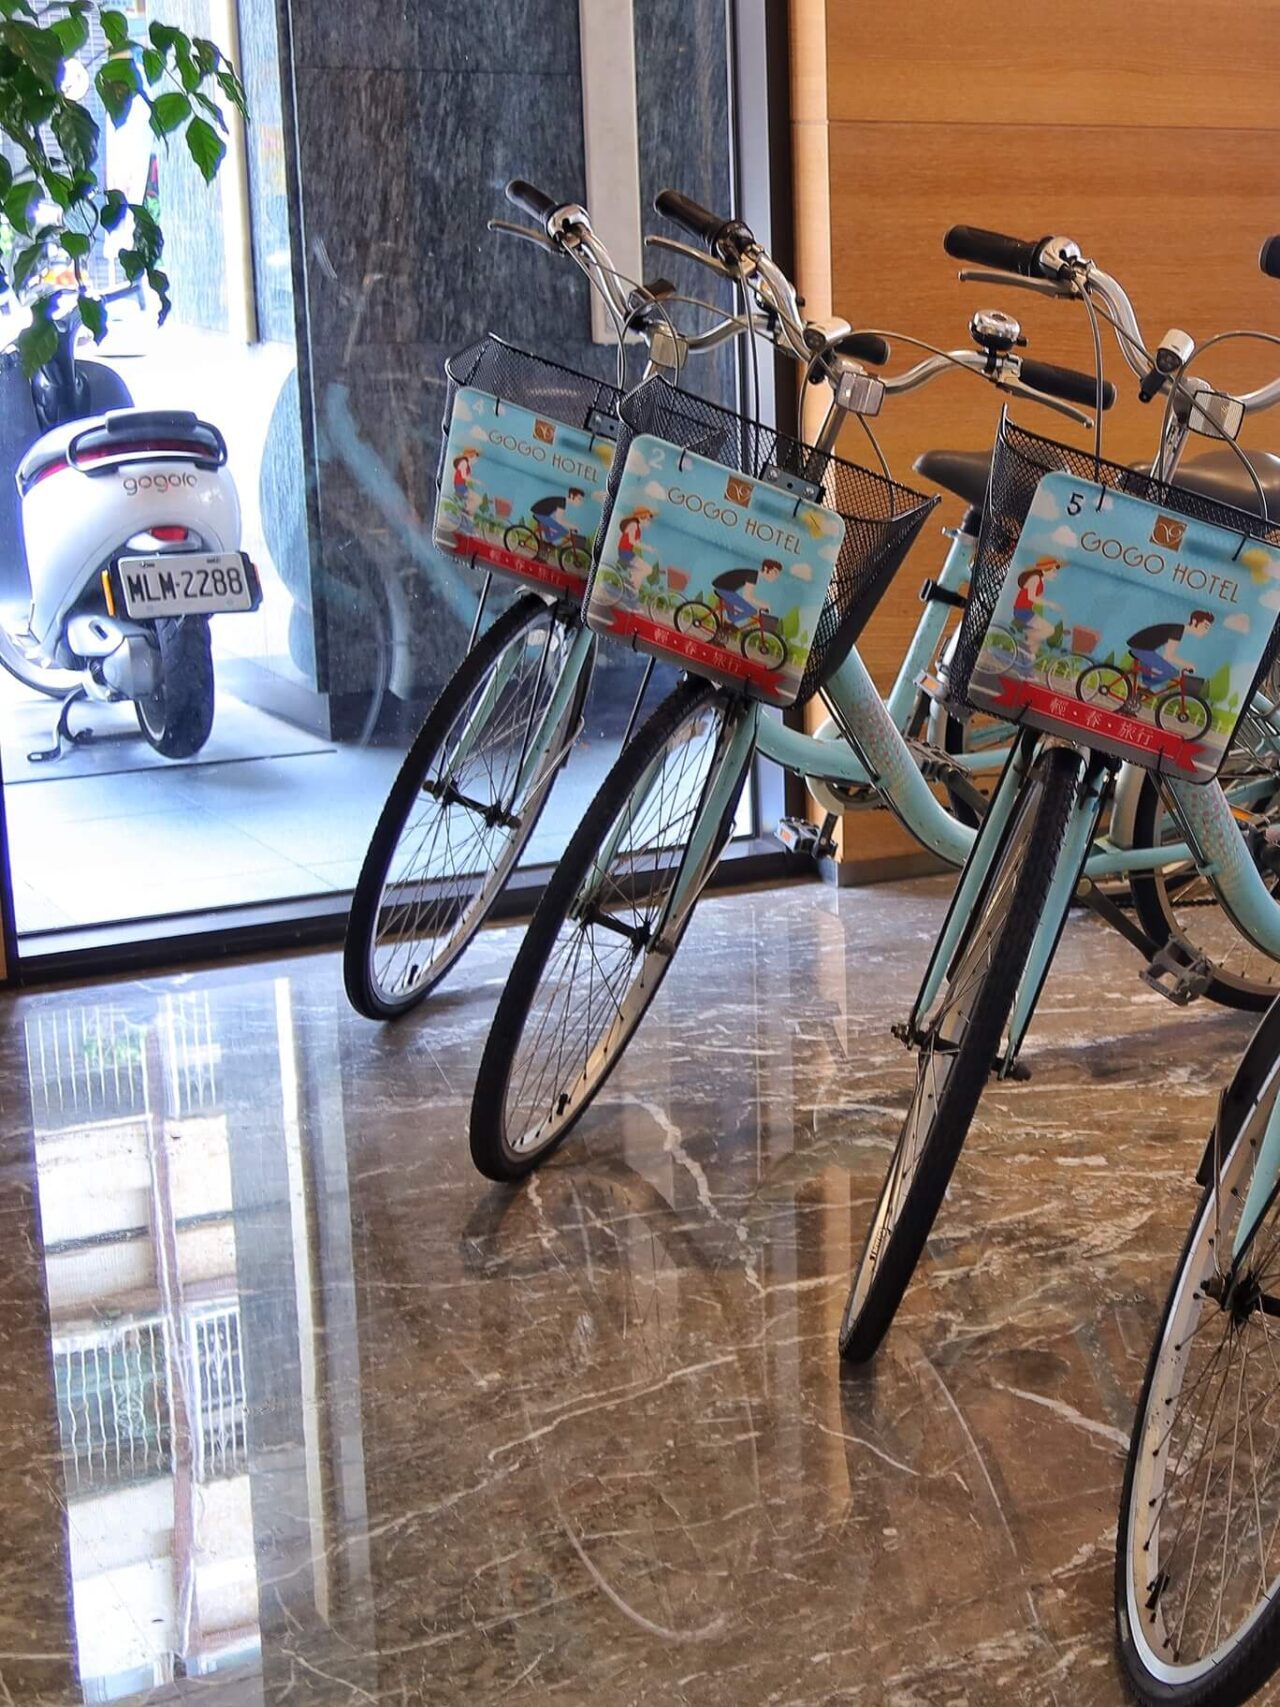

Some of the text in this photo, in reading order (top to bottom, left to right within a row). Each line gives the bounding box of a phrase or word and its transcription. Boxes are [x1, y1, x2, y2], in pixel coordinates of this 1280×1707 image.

[489, 430, 599, 482] GOGO HOTEL
[650, 449, 666, 470] 2
[668, 487, 801, 555] GOGO HOTEL
[1067, 492, 1084, 516] 5
[126, 567, 243, 603] MLM-2288
[1080, 531, 1239, 603] GOGO HOTEL
